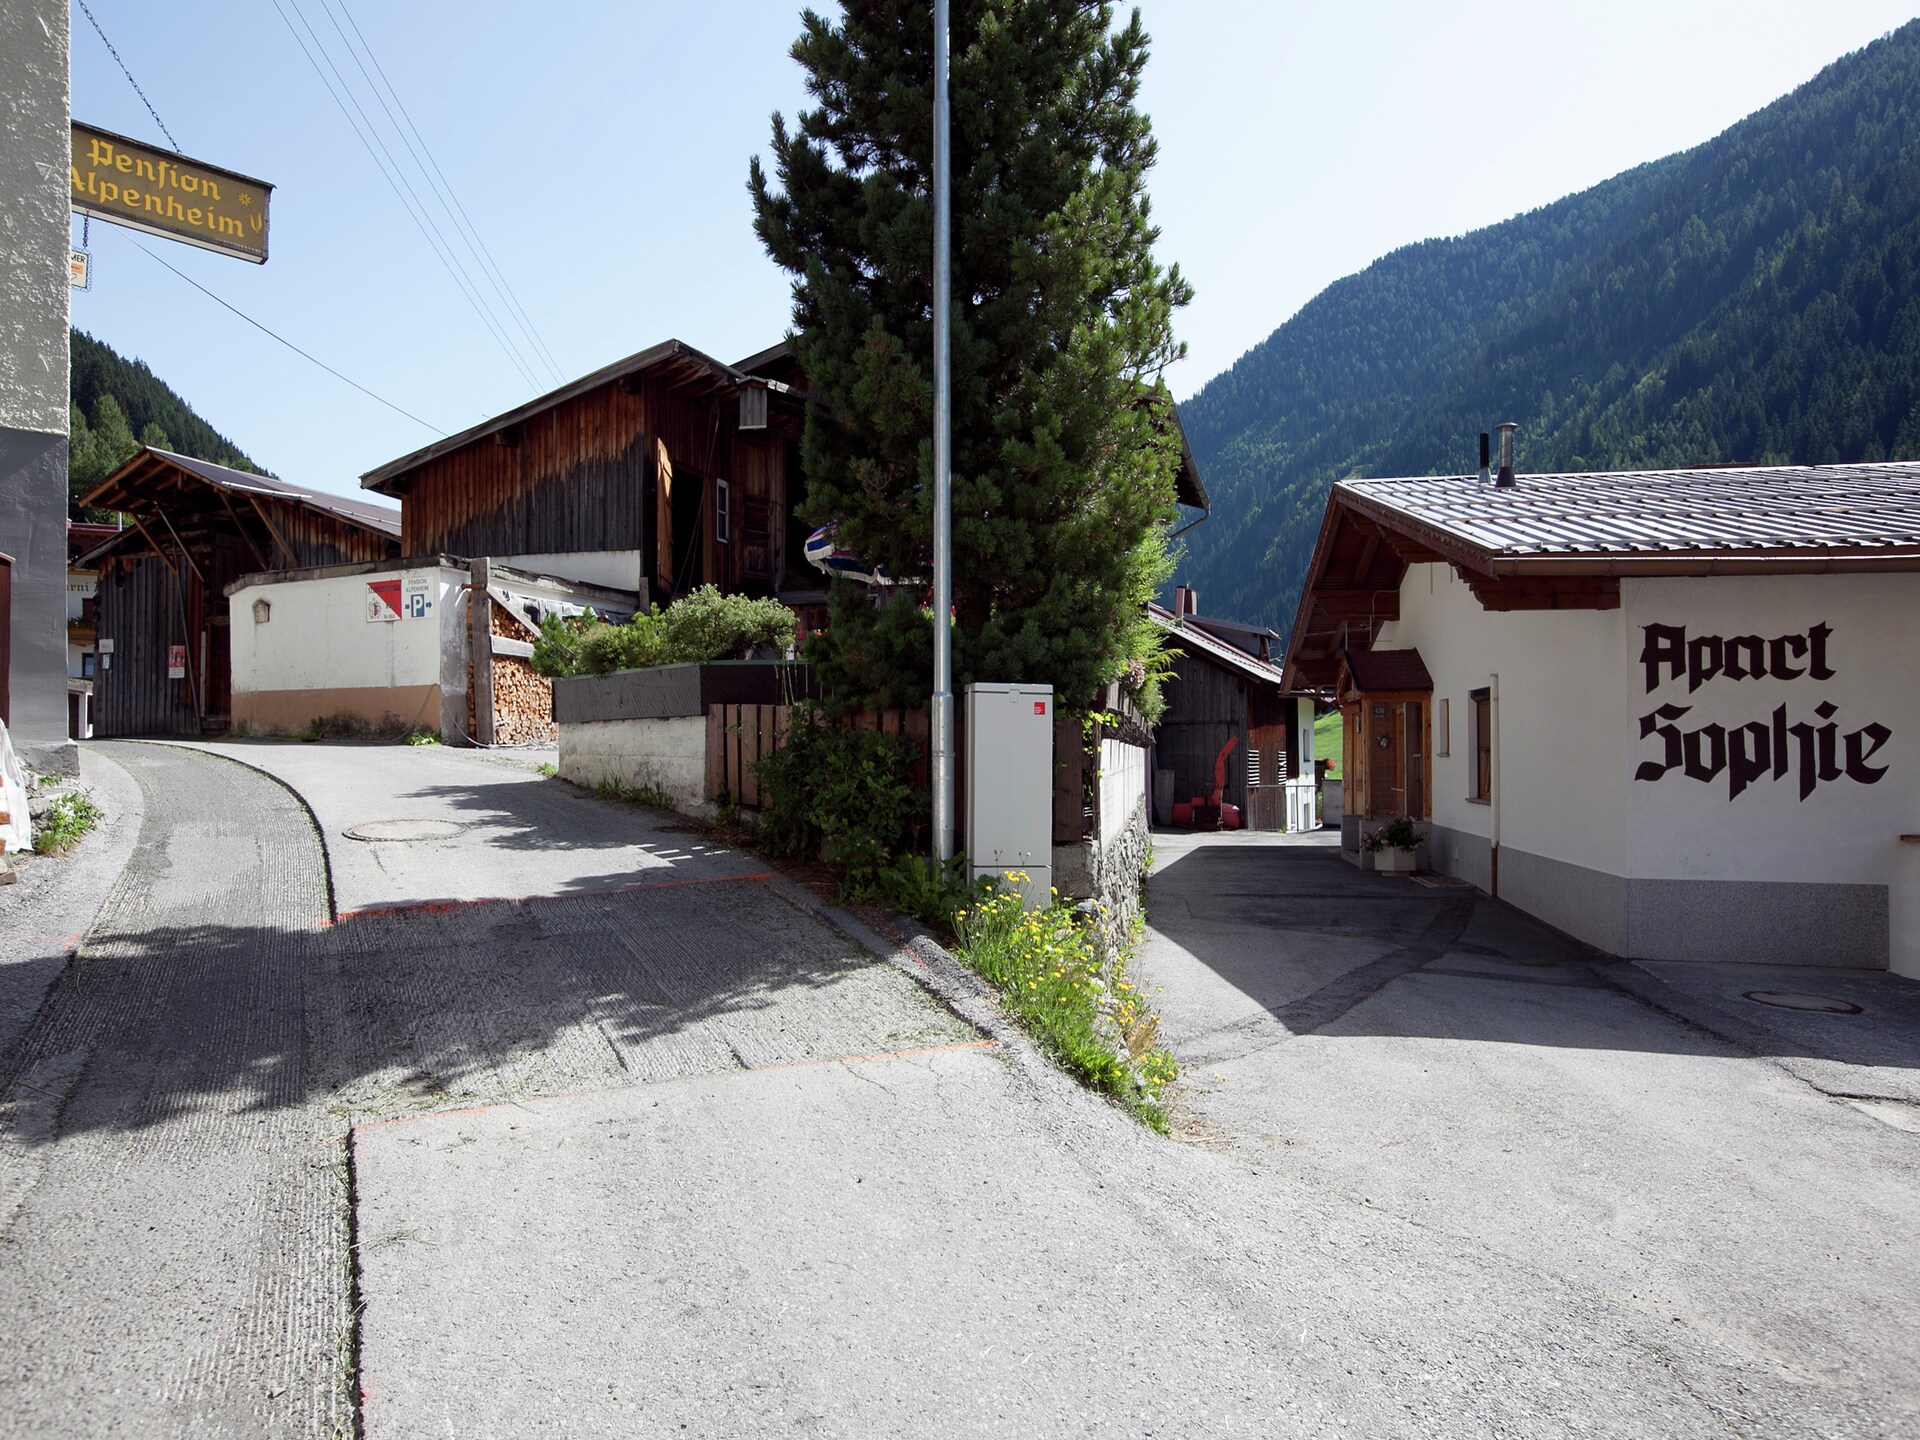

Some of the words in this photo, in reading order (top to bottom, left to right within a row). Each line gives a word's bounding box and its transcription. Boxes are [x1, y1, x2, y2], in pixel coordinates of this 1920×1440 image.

[71, 165, 245, 238] Alpenheim
[412, 595, 423, 617] P
[1634, 700, 1892, 803] Sophie
